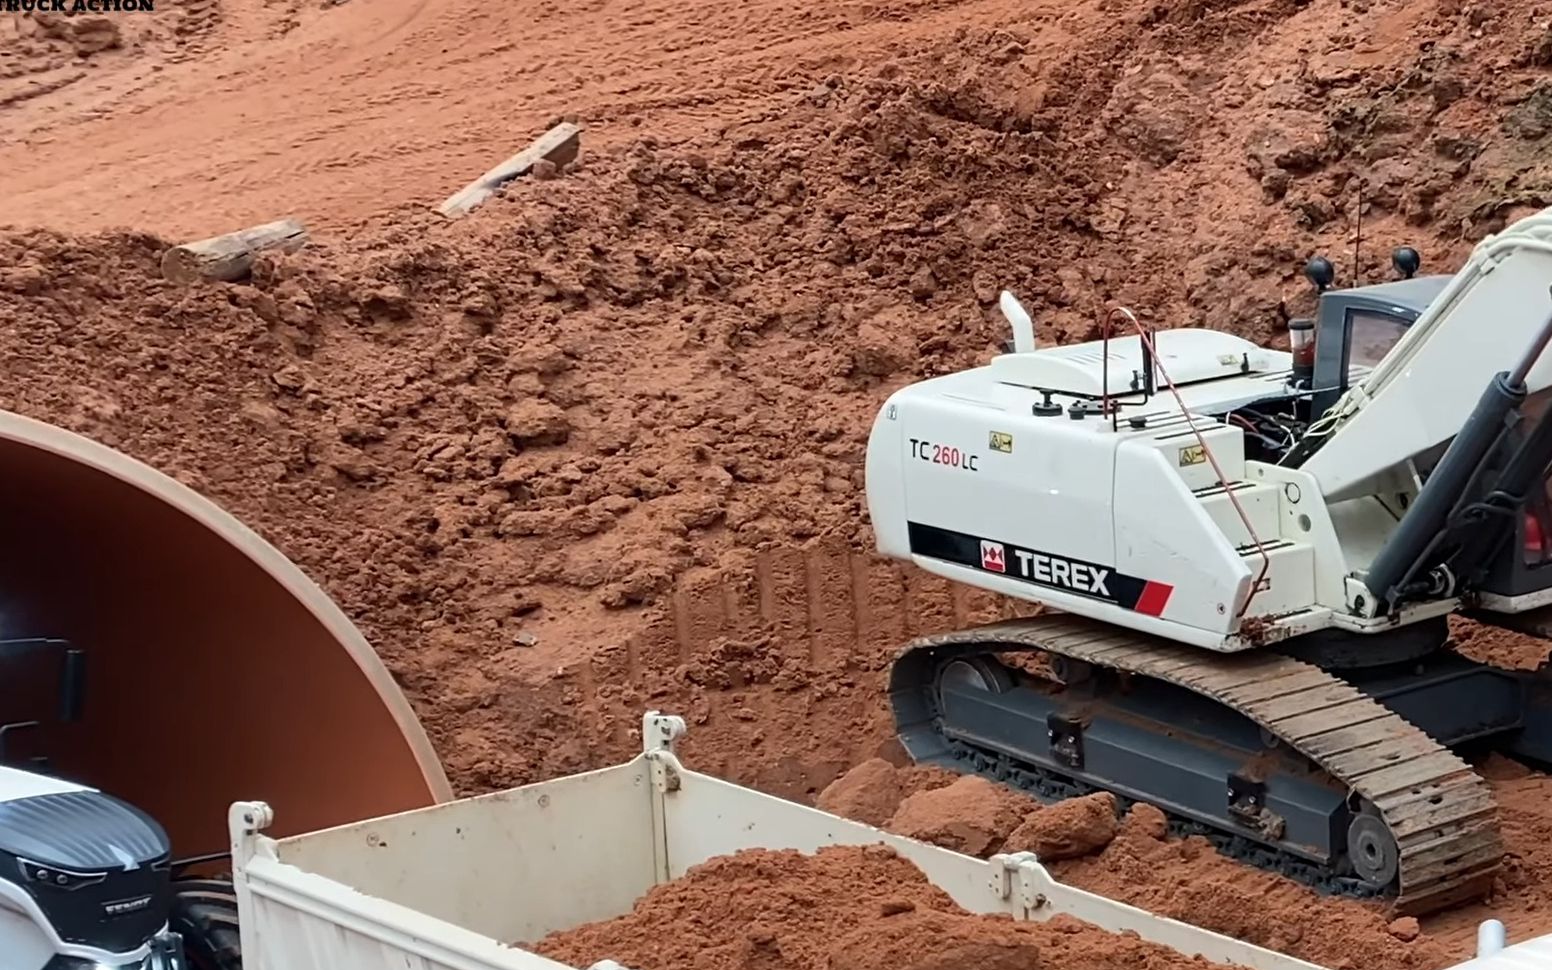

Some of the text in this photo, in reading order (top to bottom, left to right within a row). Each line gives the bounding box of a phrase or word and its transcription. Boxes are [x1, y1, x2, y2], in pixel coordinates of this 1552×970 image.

[909, 438, 979, 472] TC 260 LC
[1015, 549, 1110, 596] TEREX
